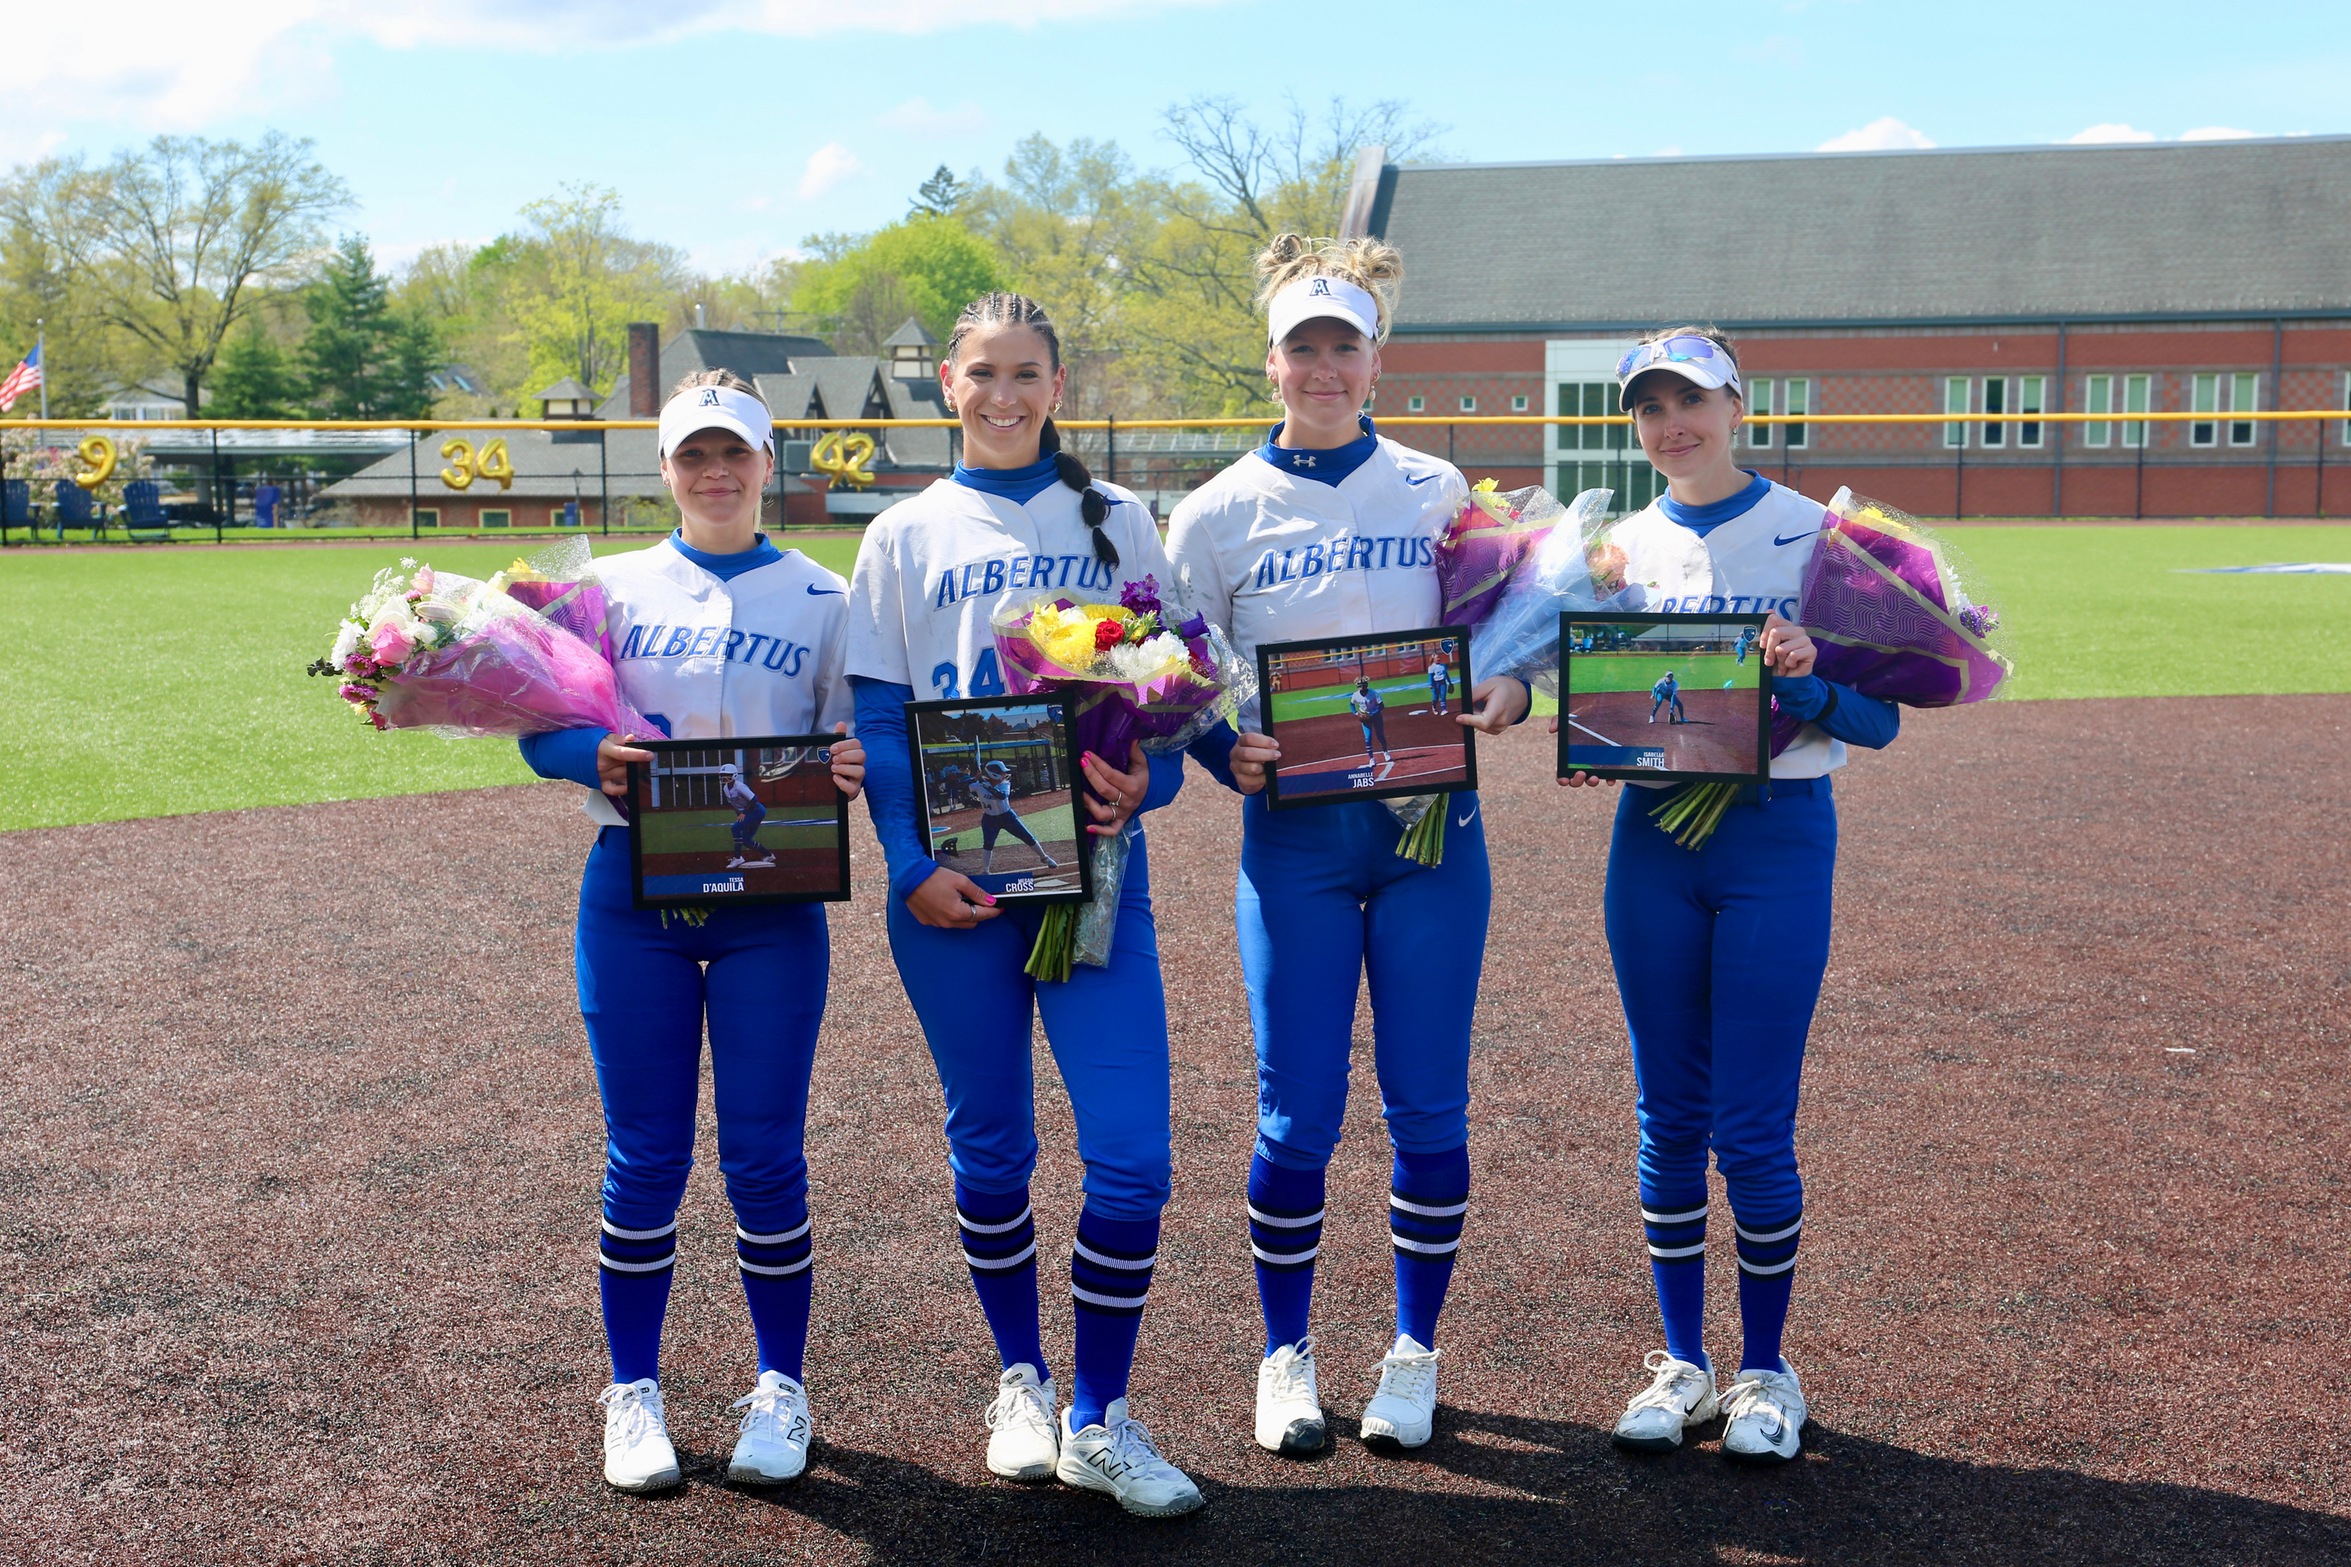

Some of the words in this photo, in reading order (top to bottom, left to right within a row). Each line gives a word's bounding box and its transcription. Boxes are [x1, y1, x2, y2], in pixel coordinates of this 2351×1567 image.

[1309, 278, 1331, 296] A
[699, 388, 721, 407] A
[76, 435, 116, 489] 9
[441, 438, 514, 490] 34
[810, 432, 875, 488] 42
[1253, 535, 1435, 591] ALBERTUS
[934, 554, 1114, 611] ALBERTUS
[1661, 593, 1799, 622] BERTUS
[619, 623, 810, 680] ALBERTUS
[1636, 756, 1665, 767] SMITH
[1352, 777, 1374, 788] JABS
[703, 881, 744, 893] D'AQUILA
[1005, 881, 1034, 893] CROSS
